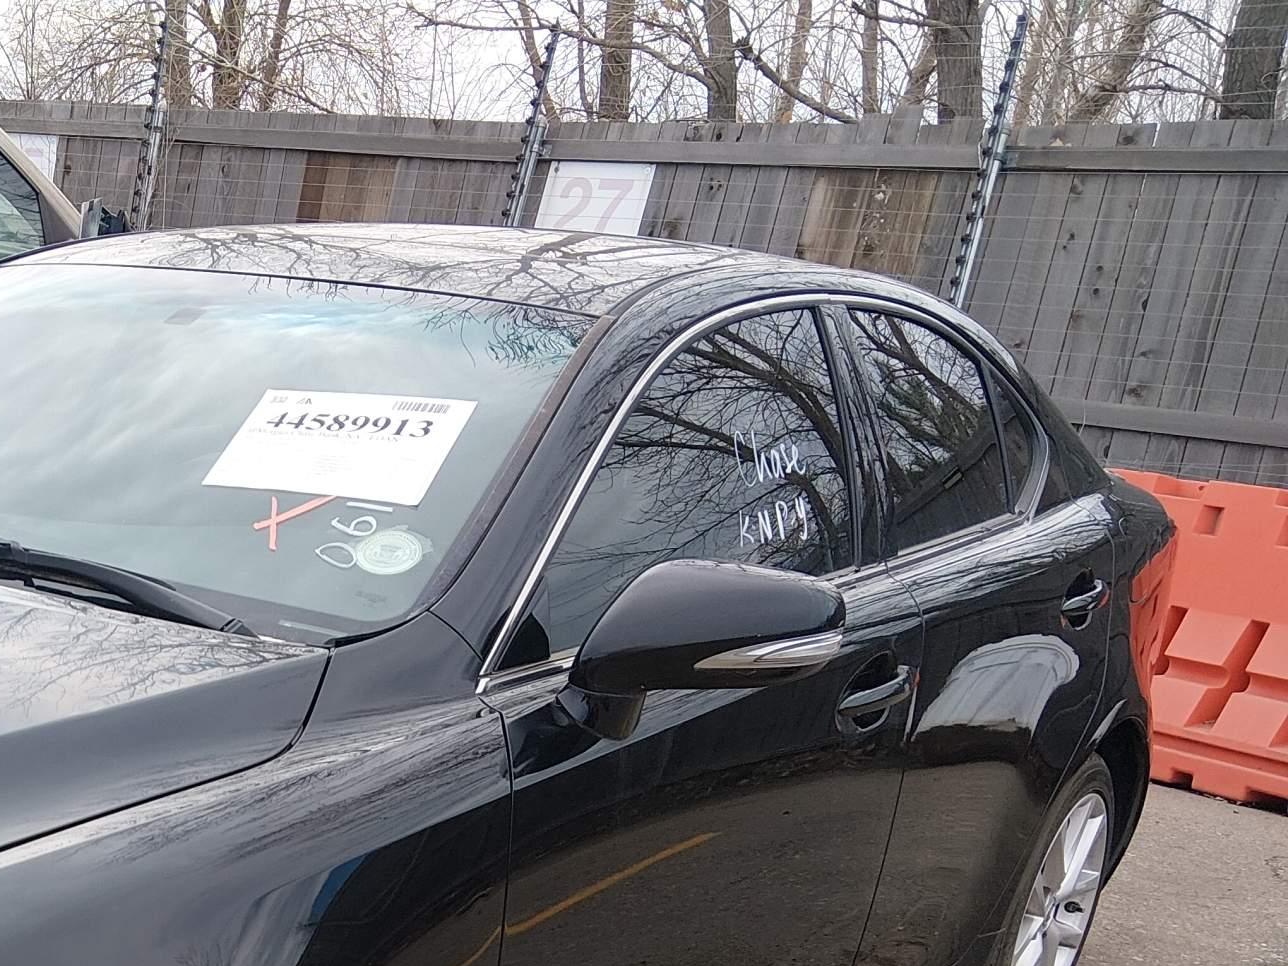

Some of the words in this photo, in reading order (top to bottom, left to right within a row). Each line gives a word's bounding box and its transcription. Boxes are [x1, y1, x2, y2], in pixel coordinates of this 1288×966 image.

[553, 177, 634, 232] 27
[266, 411, 434, 438] 44589913
[734, 429, 806, 487] Chase
